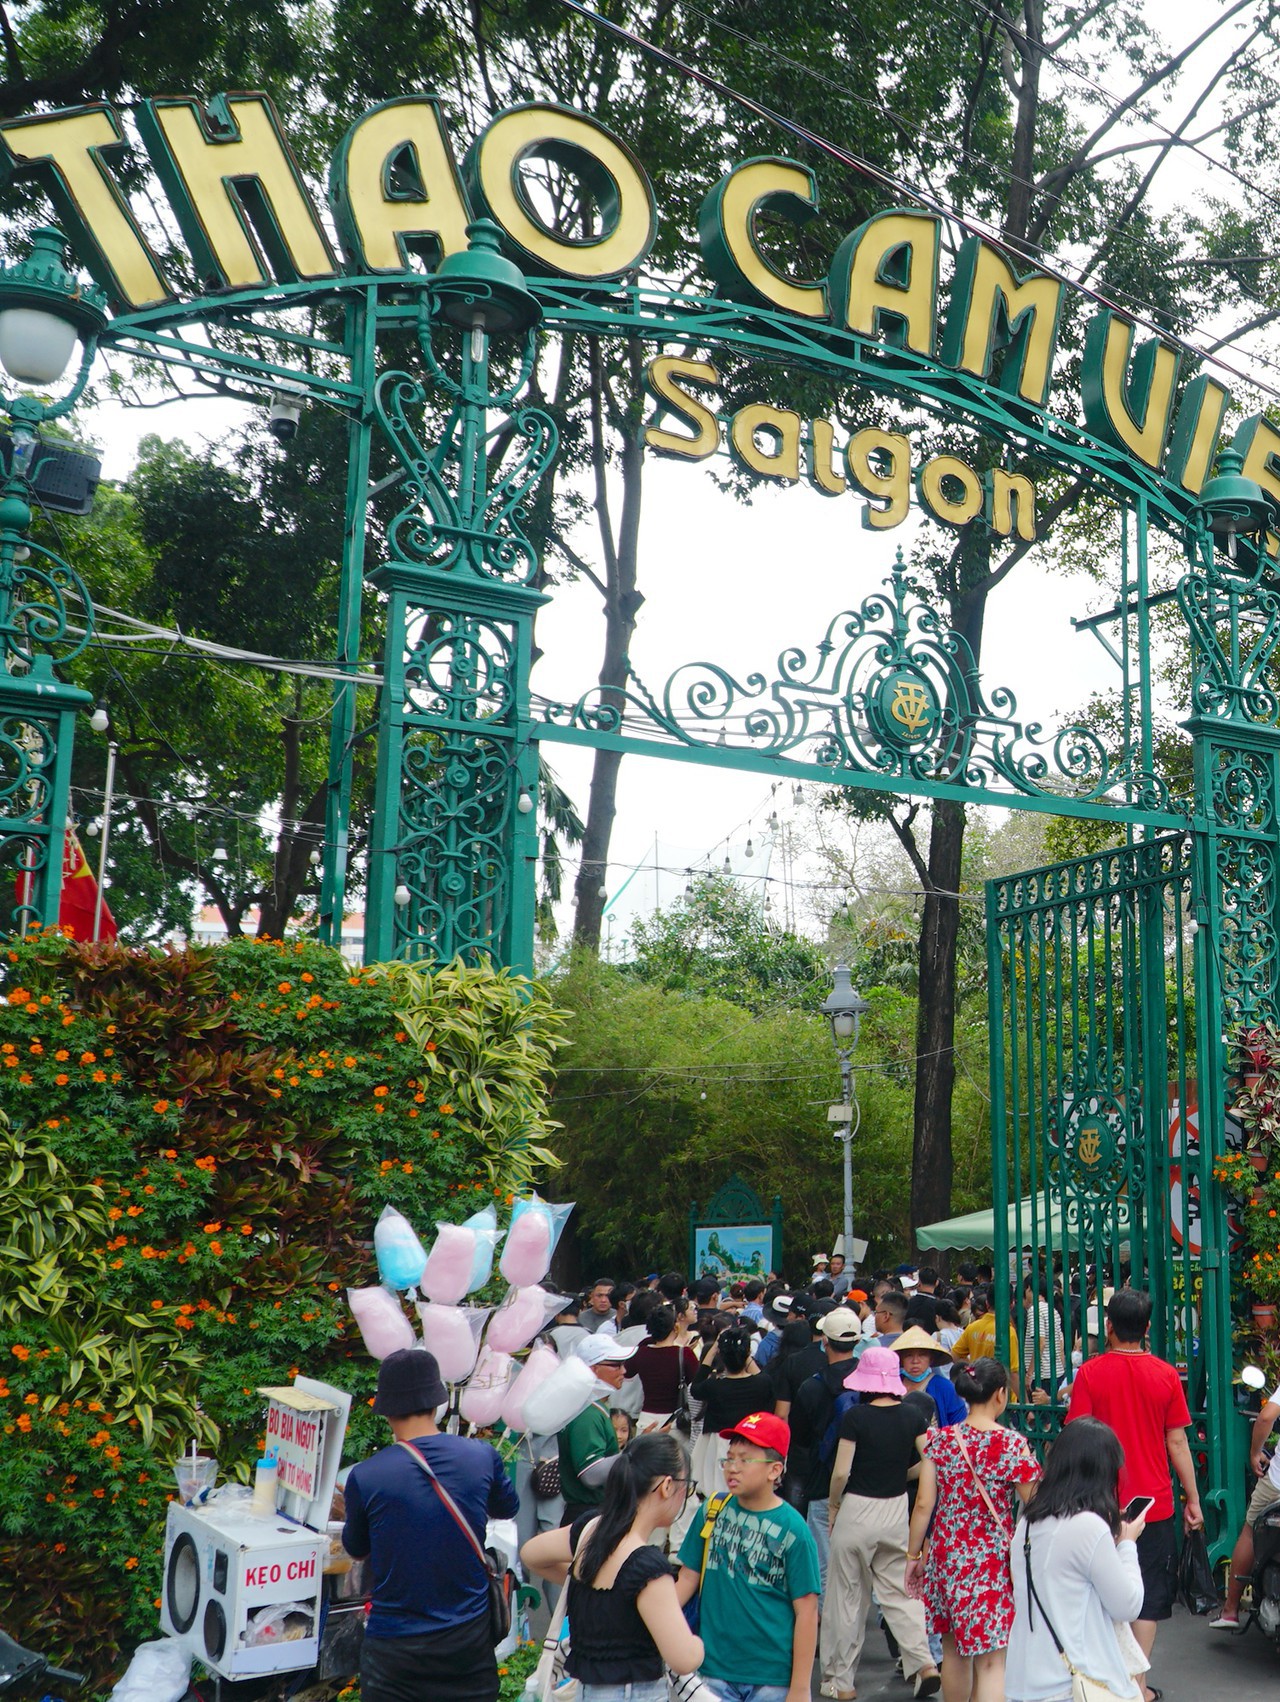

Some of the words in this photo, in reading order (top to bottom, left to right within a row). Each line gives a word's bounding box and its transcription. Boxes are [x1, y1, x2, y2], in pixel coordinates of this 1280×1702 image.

[702, 155, 1067, 407] CAM
[245, 1564, 282, 1589] KẸO
[286, 1551, 317, 1580] CHỈ
